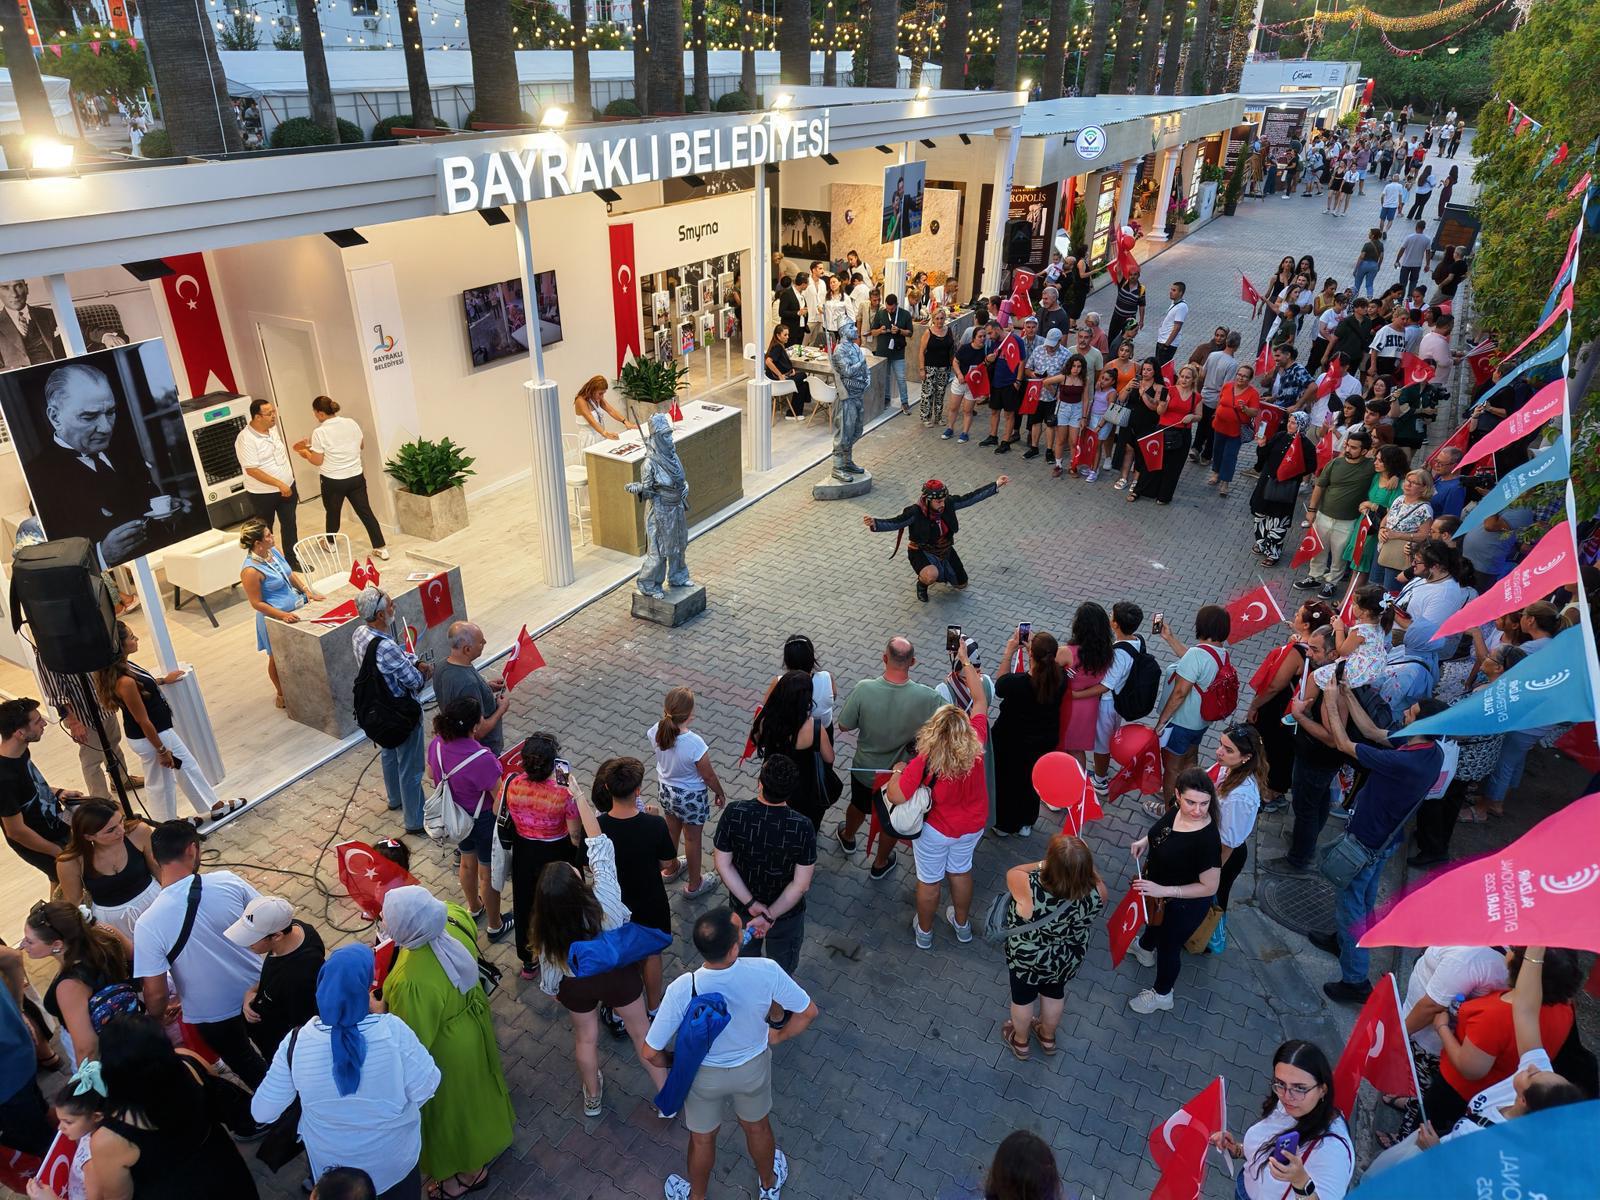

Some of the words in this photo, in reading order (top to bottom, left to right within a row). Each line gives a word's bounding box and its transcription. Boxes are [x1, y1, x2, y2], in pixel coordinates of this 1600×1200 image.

[443, 135, 659, 214] BAYRAKLI
[670, 108, 830, 178] BELEDİYESİ
[1009, 191, 1047, 203] ROPOLİS
[678, 221, 719, 242] Smyrna
[373, 351, 403, 364] BAYRAKLI
[374, 358, 405, 371] BELEDİYESİ
